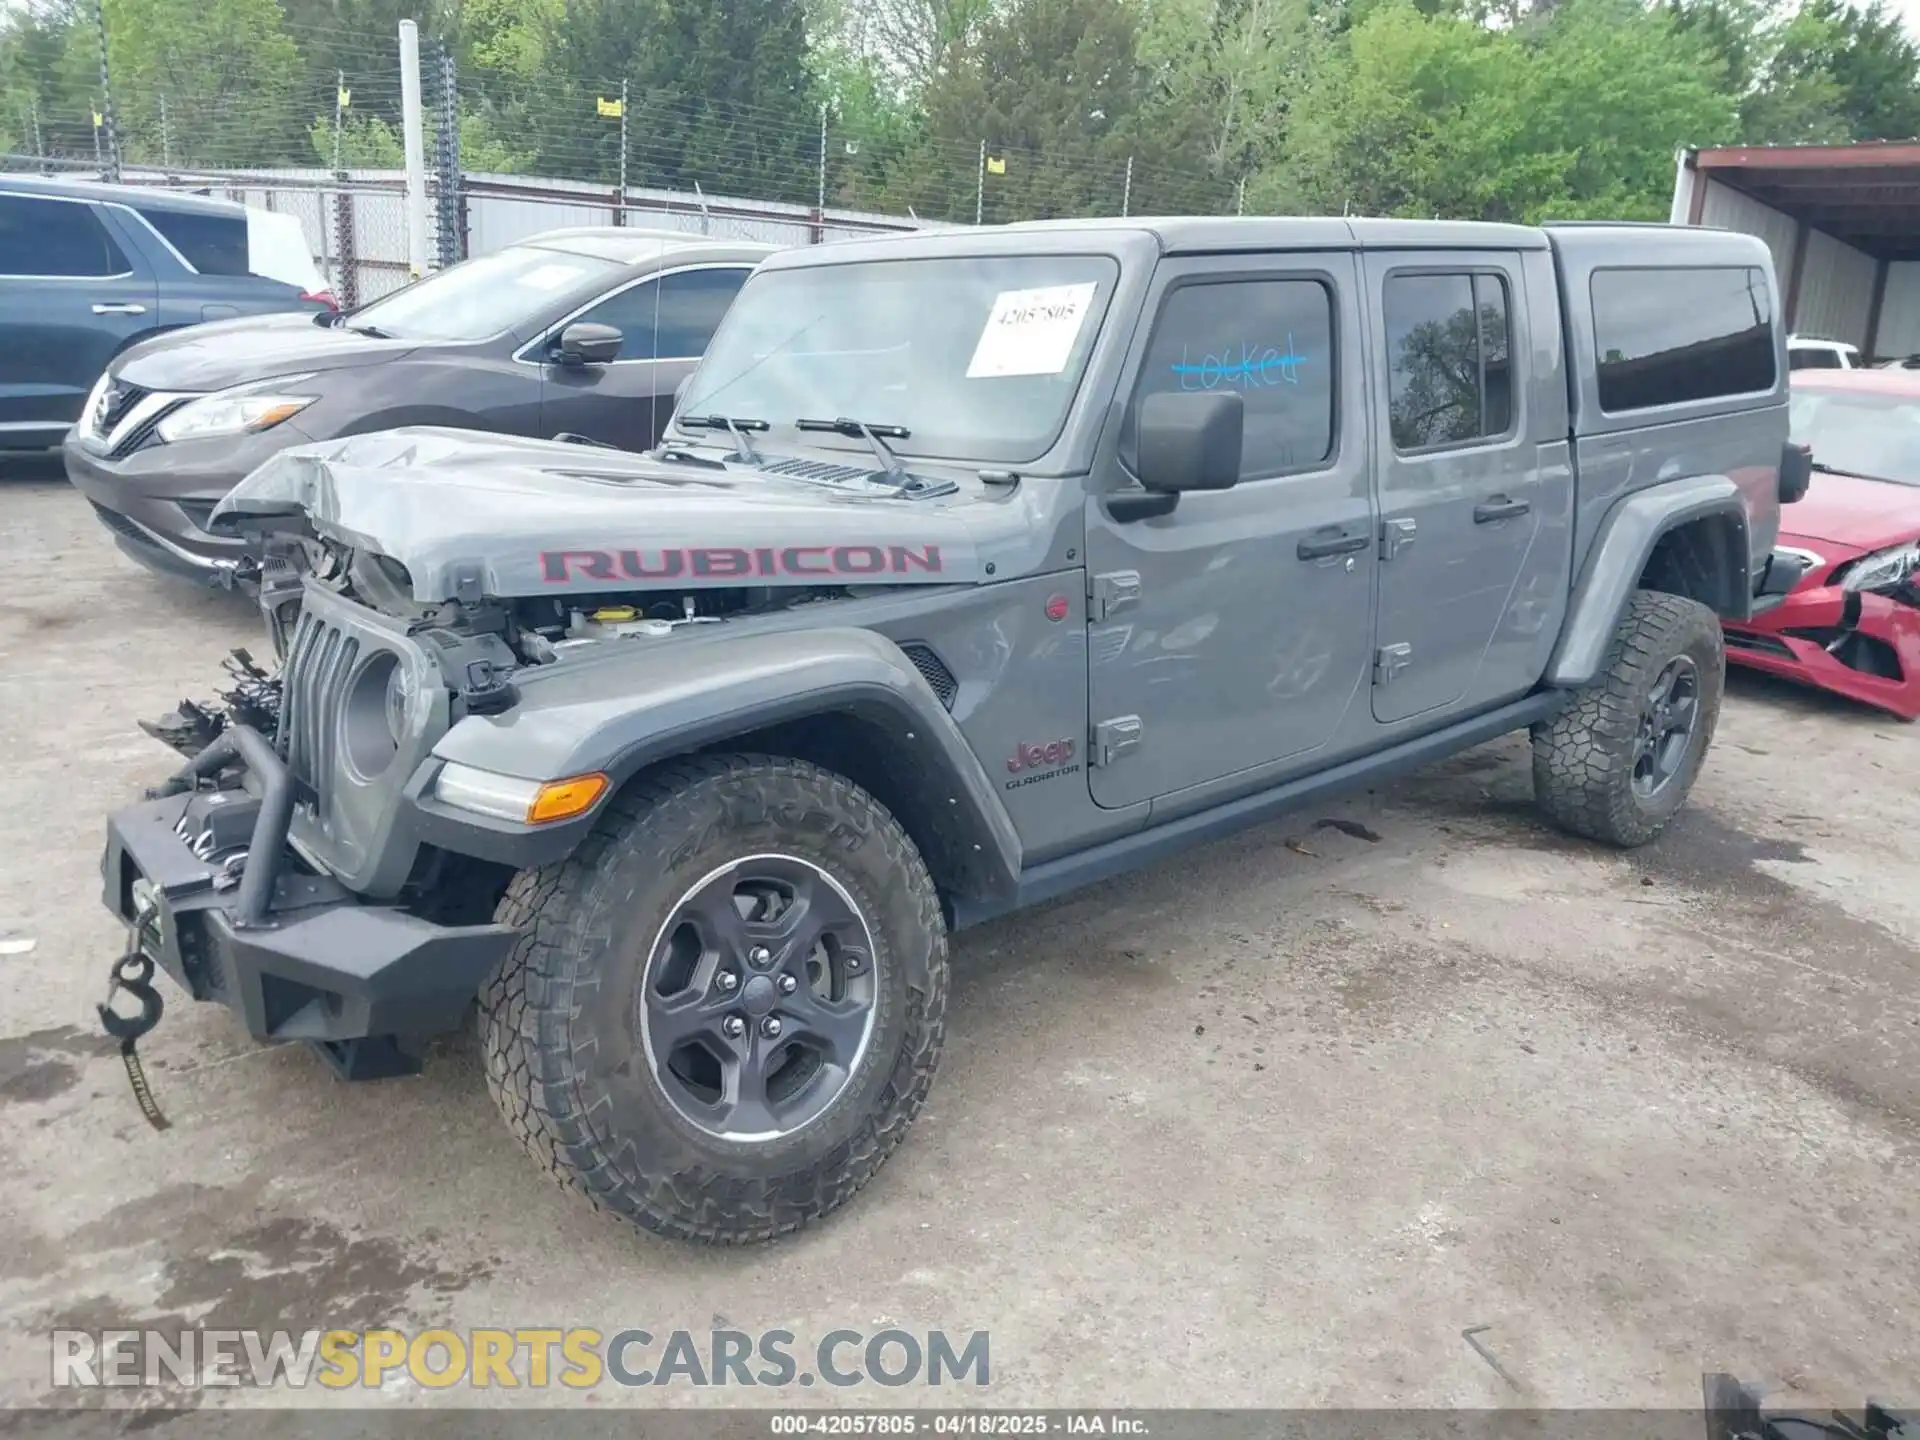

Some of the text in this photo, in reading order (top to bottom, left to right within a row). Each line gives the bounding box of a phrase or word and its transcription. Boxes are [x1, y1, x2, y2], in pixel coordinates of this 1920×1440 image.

[540, 544, 942, 583] RUBICON
[1006, 738, 1076, 774] Jeep
[1005, 764, 1080, 790] GLADIATOR
